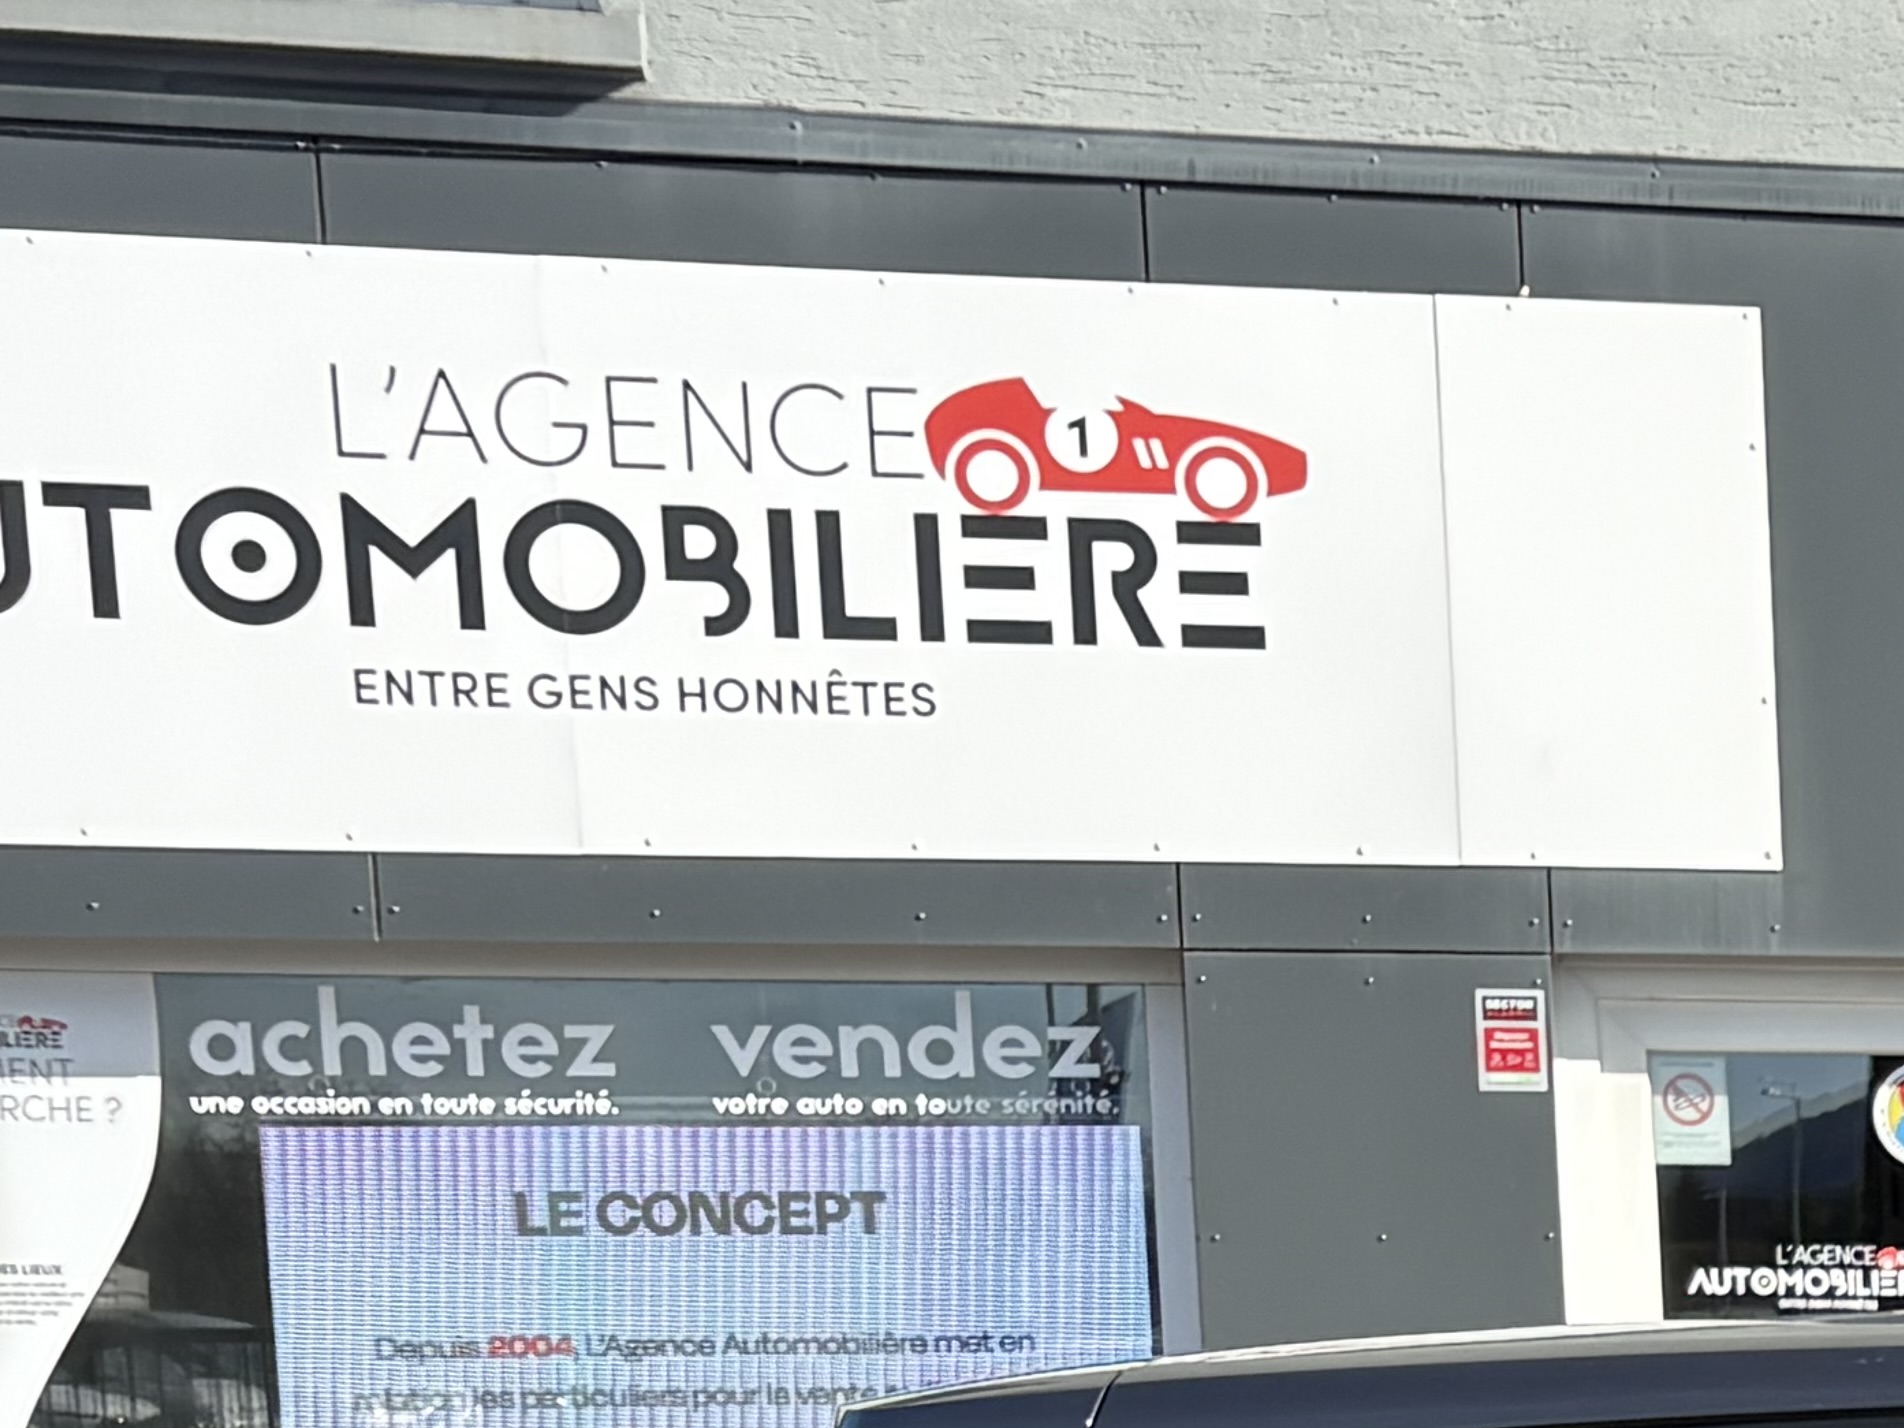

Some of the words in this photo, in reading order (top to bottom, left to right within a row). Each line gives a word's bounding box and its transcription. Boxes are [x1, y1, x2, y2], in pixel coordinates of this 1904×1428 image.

[330, 362, 925, 479] L'AGENCE
[1066, 415, 1089, 459] 1
[353, 668, 512, 709] ENTRE
[527, 672, 660, 713] GENS
[678, 667, 938, 718] HONNÊTES
[188, 984, 618, 1079] achetez
[709, 989, 1102, 1080] vendez
[188, 1095, 245, 1116] une
[250, 1087, 371, 1116] occasion
[377, 1095, 414, 1116] en
[419, 1091, 497, 1116] toute
[503, 1088, 621, 1117] sécurité.
[711, 1091, 790, 1117] votre
[795, 1091, 865, 1117] auto
[871, 1095, 908, 1117] en
[914, 1091, 993, 1117] toute
[513, 1190, 586, 1238] LE
[595, 1189, 888, 1238] CONCEPT
[1775, 1243, 1878, 1267] L'AGENCE
